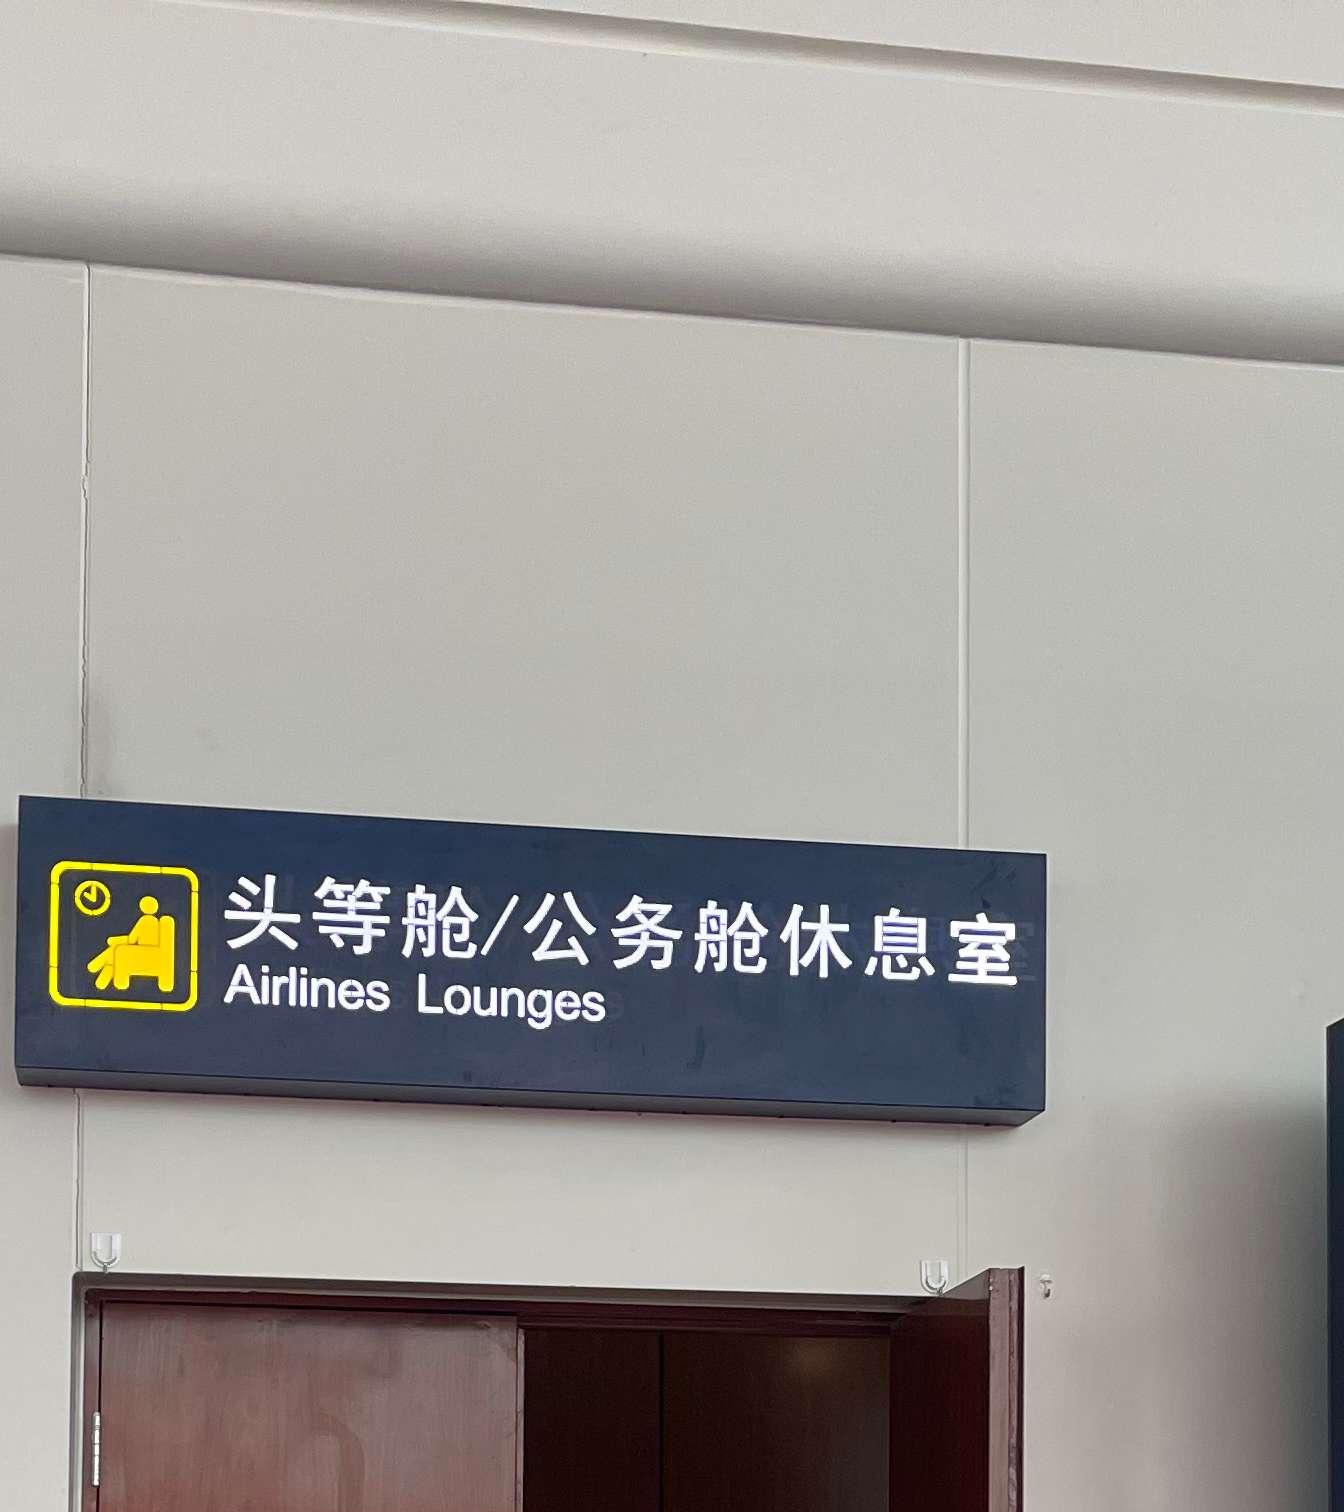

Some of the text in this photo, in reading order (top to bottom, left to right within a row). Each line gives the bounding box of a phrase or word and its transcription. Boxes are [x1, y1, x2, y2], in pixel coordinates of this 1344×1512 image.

[223, 873, 1018, 986] 头等舱/公务舱休息室
[223, 963, 607, 1030] Airlines Lounges
